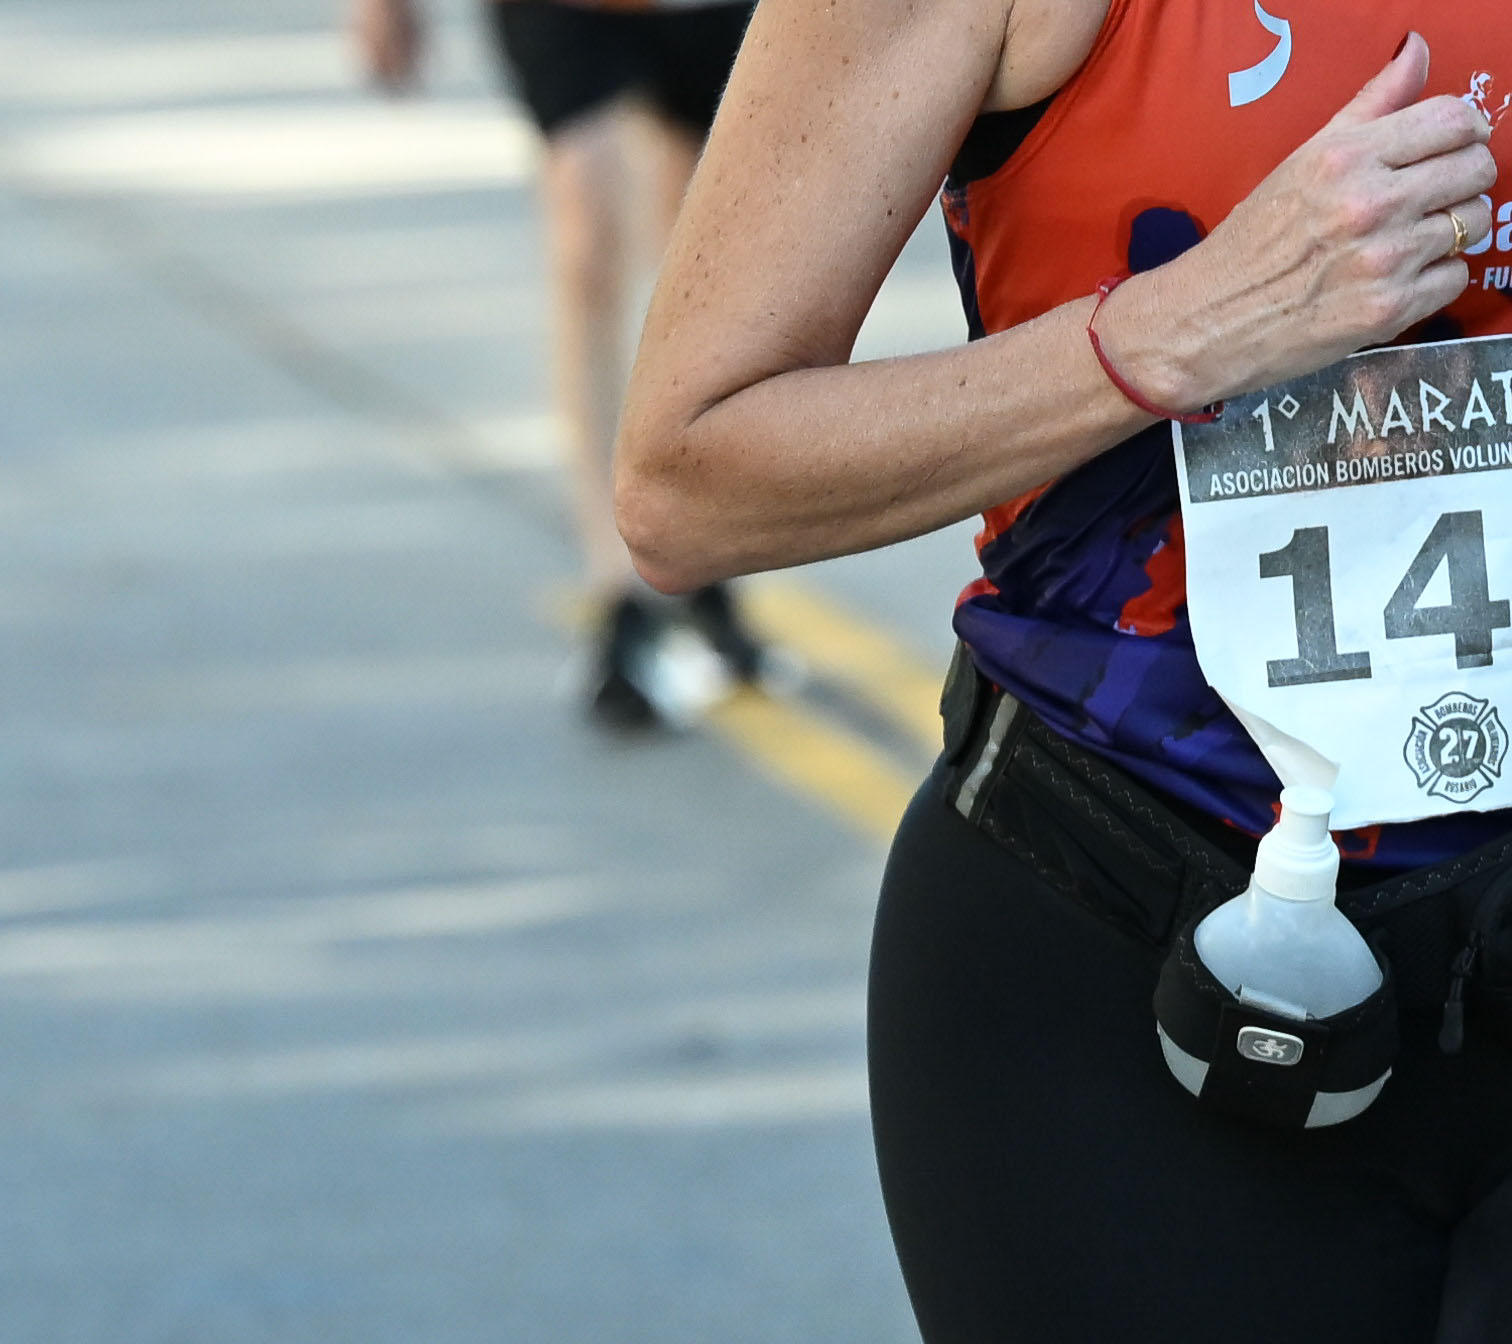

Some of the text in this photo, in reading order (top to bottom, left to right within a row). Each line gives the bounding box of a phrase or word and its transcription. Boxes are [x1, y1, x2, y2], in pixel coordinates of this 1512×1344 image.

[1209, 457, 1330, 497] ASOCIACIÓN
[1335, 448, 1445, 483] BOMBEROS
[1438, 726, 1479, 765] 27
